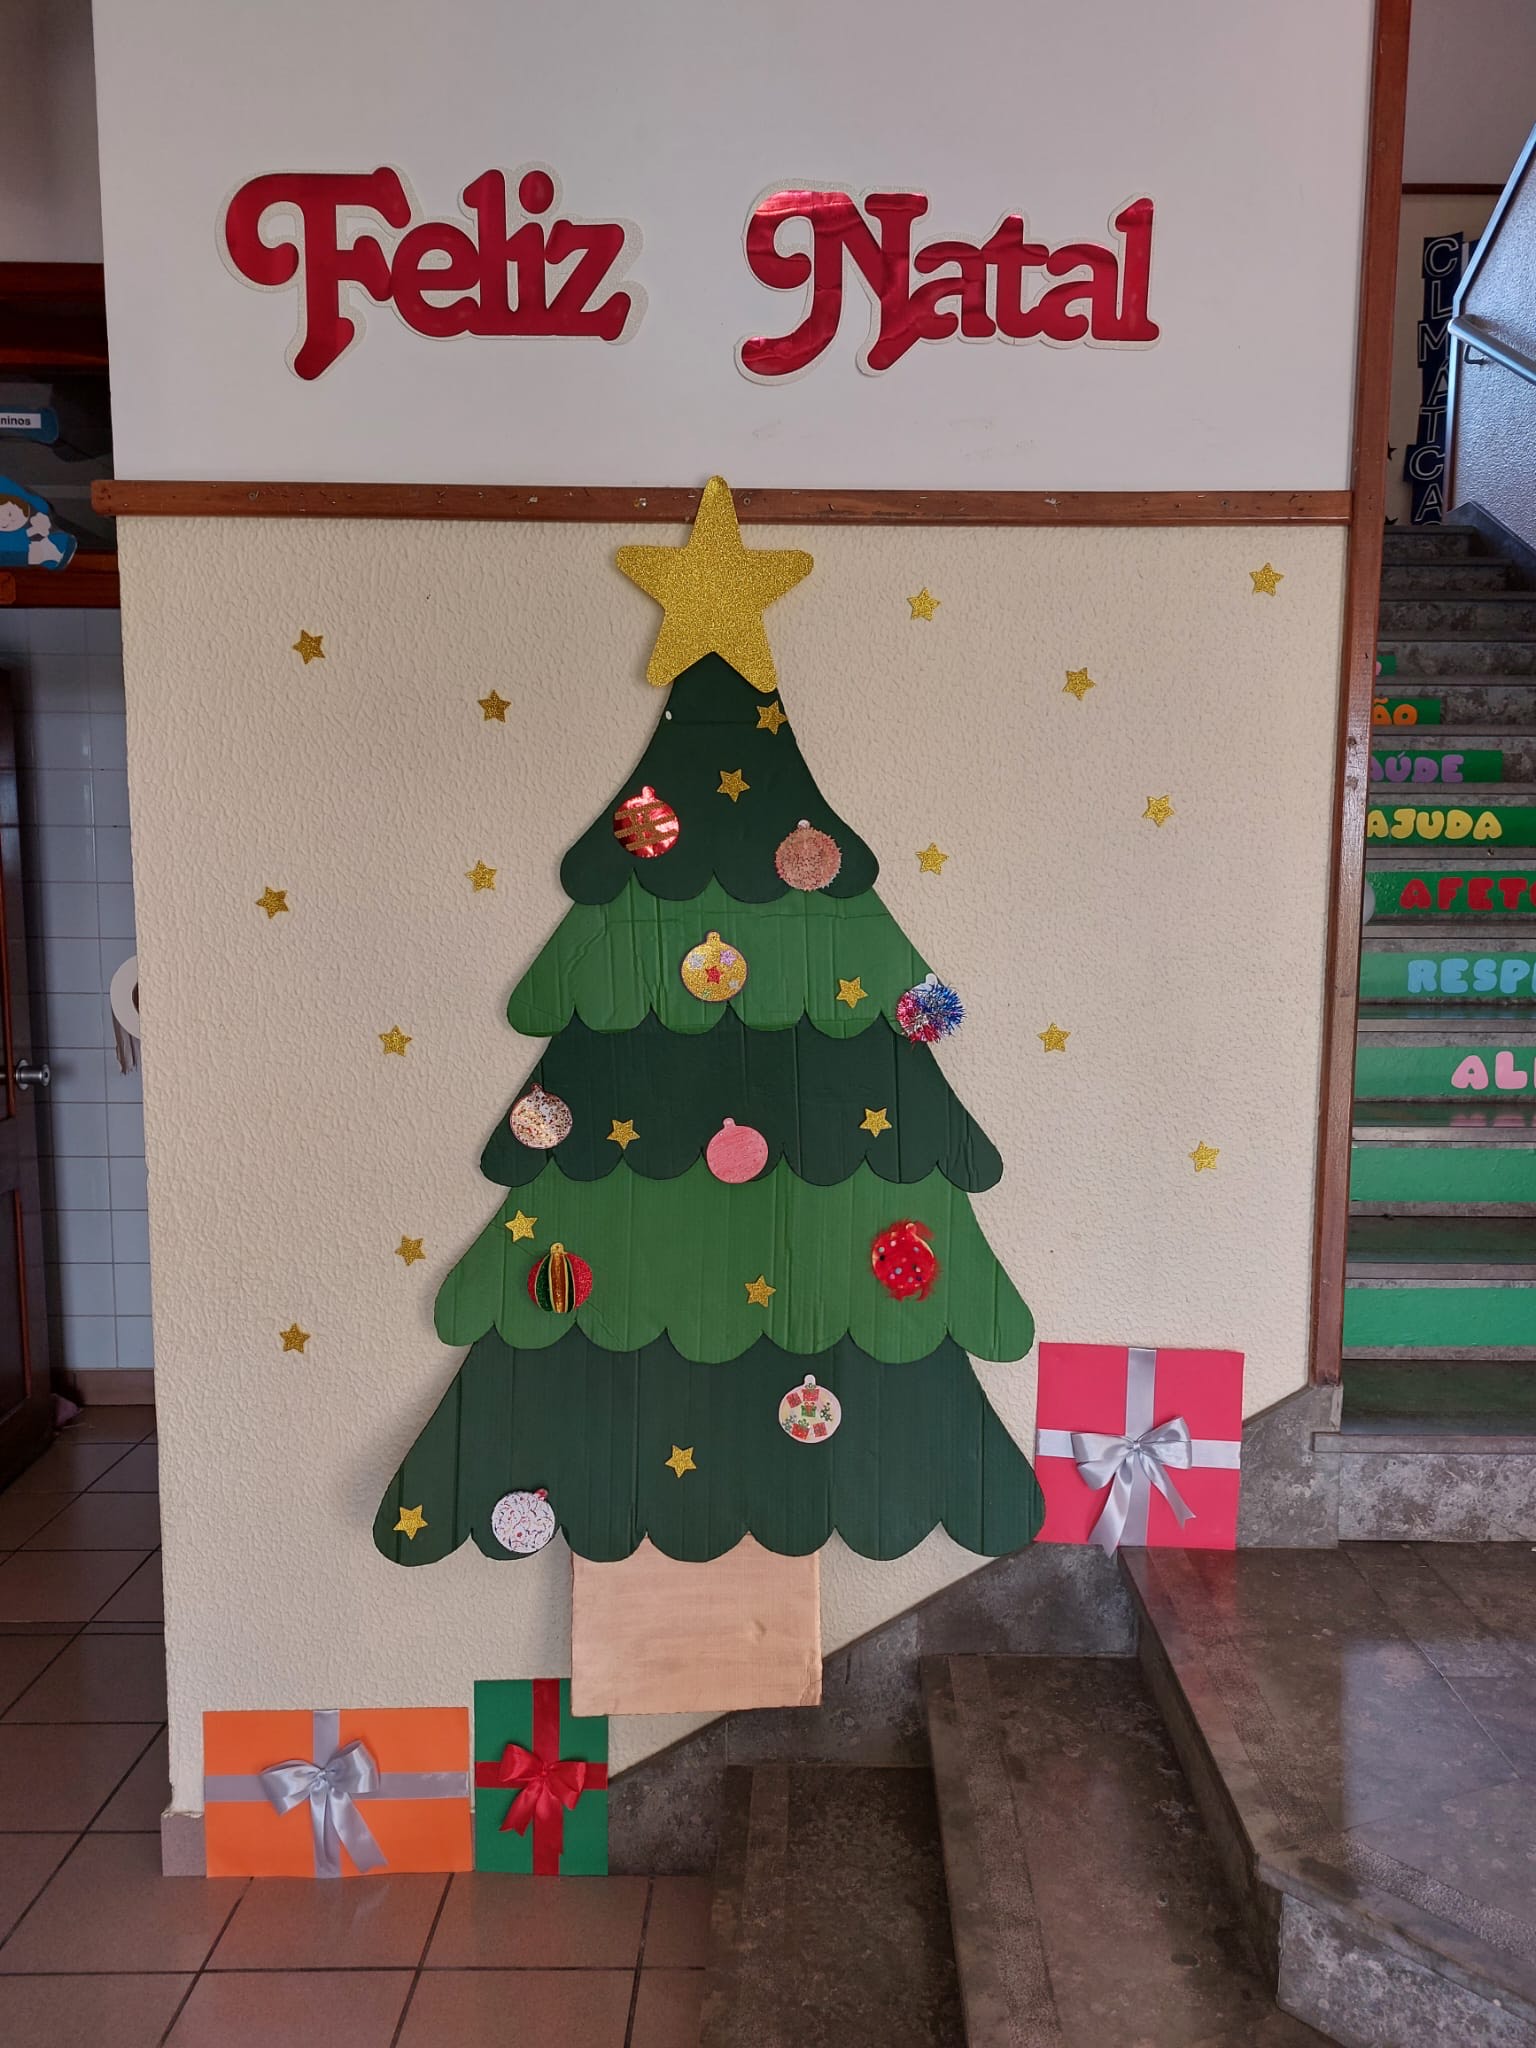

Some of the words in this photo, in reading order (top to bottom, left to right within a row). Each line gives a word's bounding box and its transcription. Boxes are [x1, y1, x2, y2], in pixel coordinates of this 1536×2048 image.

[224, 165, 634, 382] Feliz
[739, 188, 1161, 377] Natal
[1367, 808, 1503, 841] AJUDA
[1400, 877, 1536, 911] AFET
[1407, 958, 1536, 994] RESP
[1450, 1050, 1536, 1091] AL
